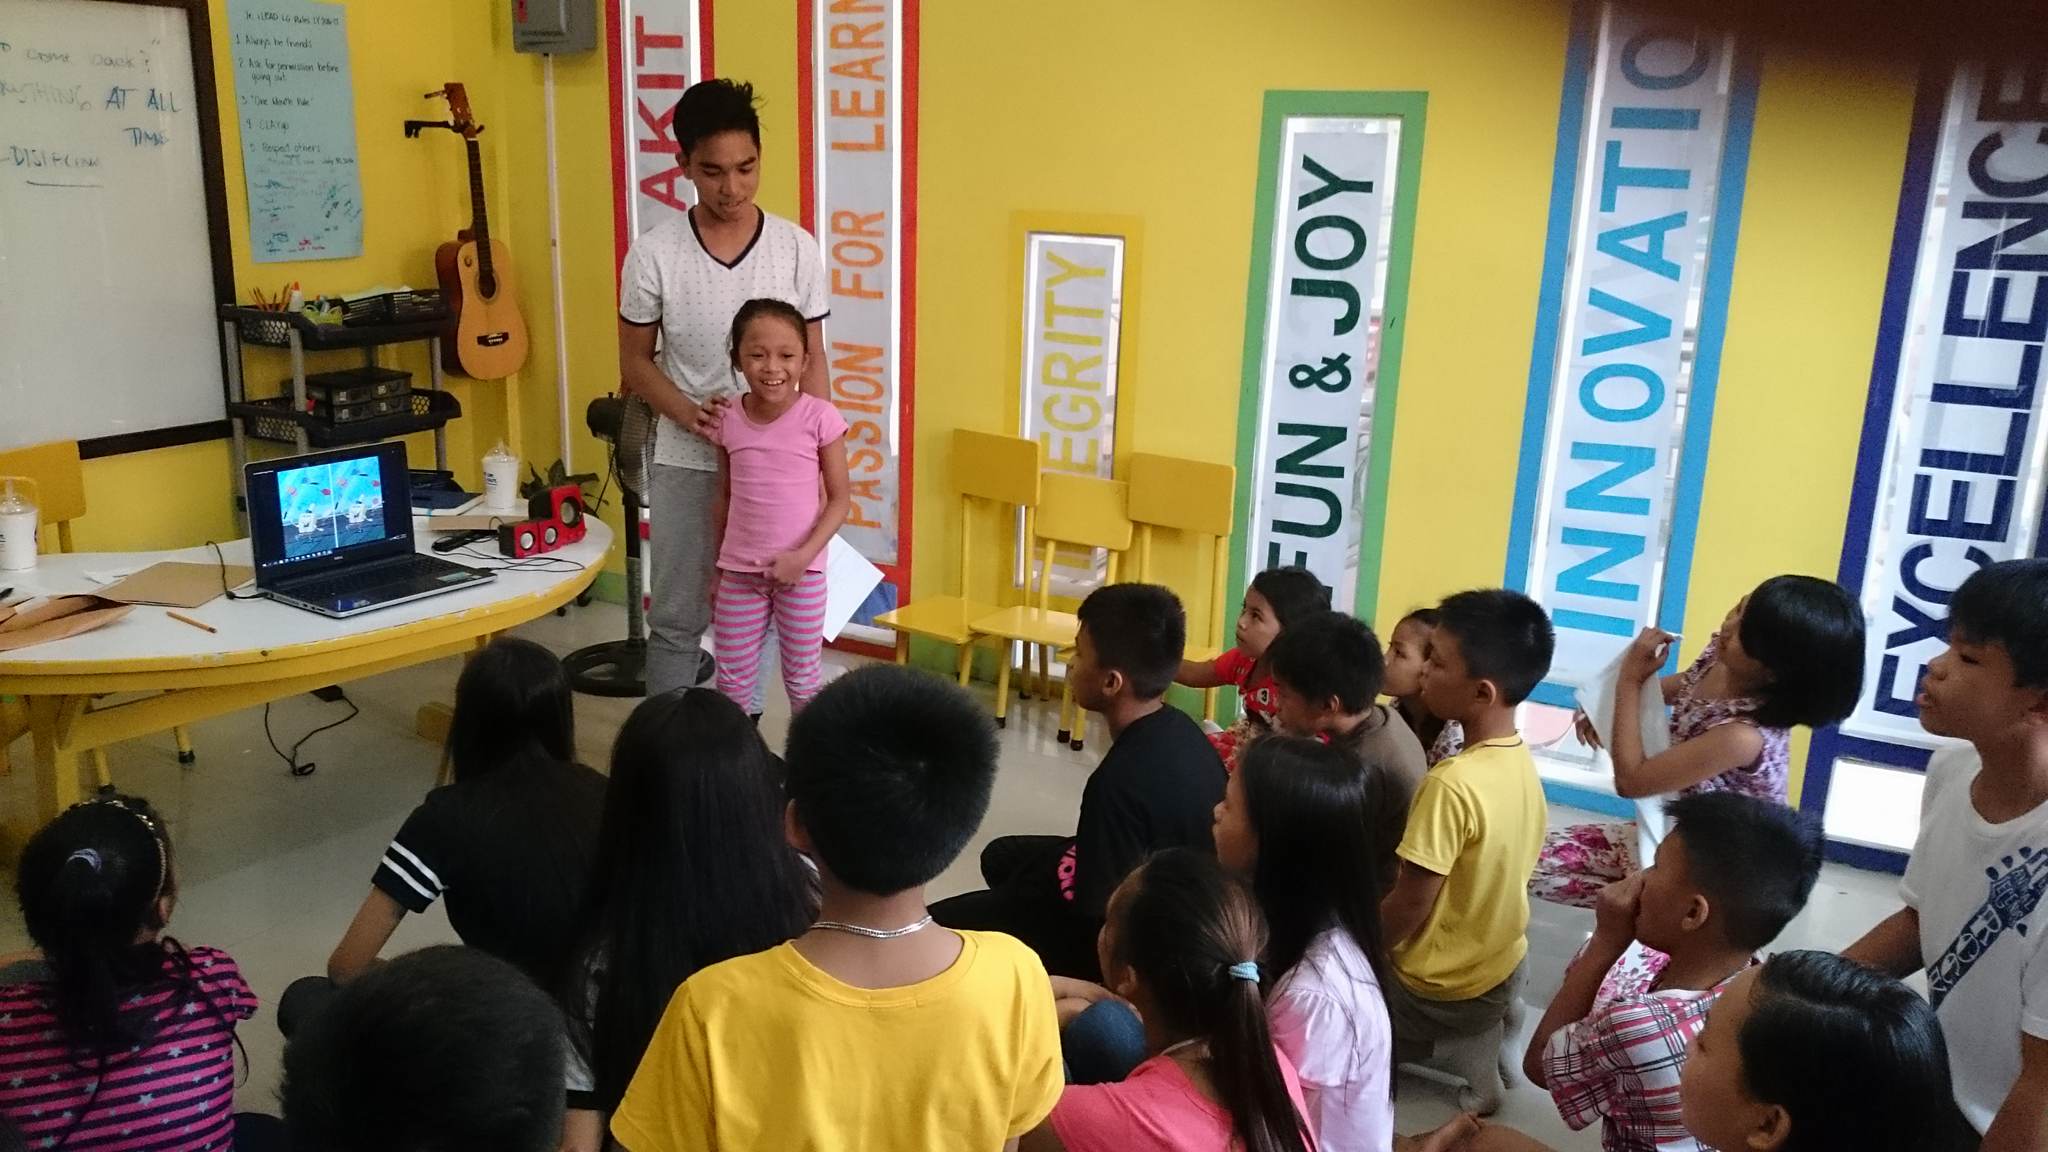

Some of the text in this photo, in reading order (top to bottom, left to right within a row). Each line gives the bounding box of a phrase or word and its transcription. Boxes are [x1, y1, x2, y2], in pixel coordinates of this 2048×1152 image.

[831, 209, 886, 300] FOR
[1289, 153, 1374, 337] JOY
[830, 341, 887, 530] PASSION
[1287, 351, 1352, 394] &
